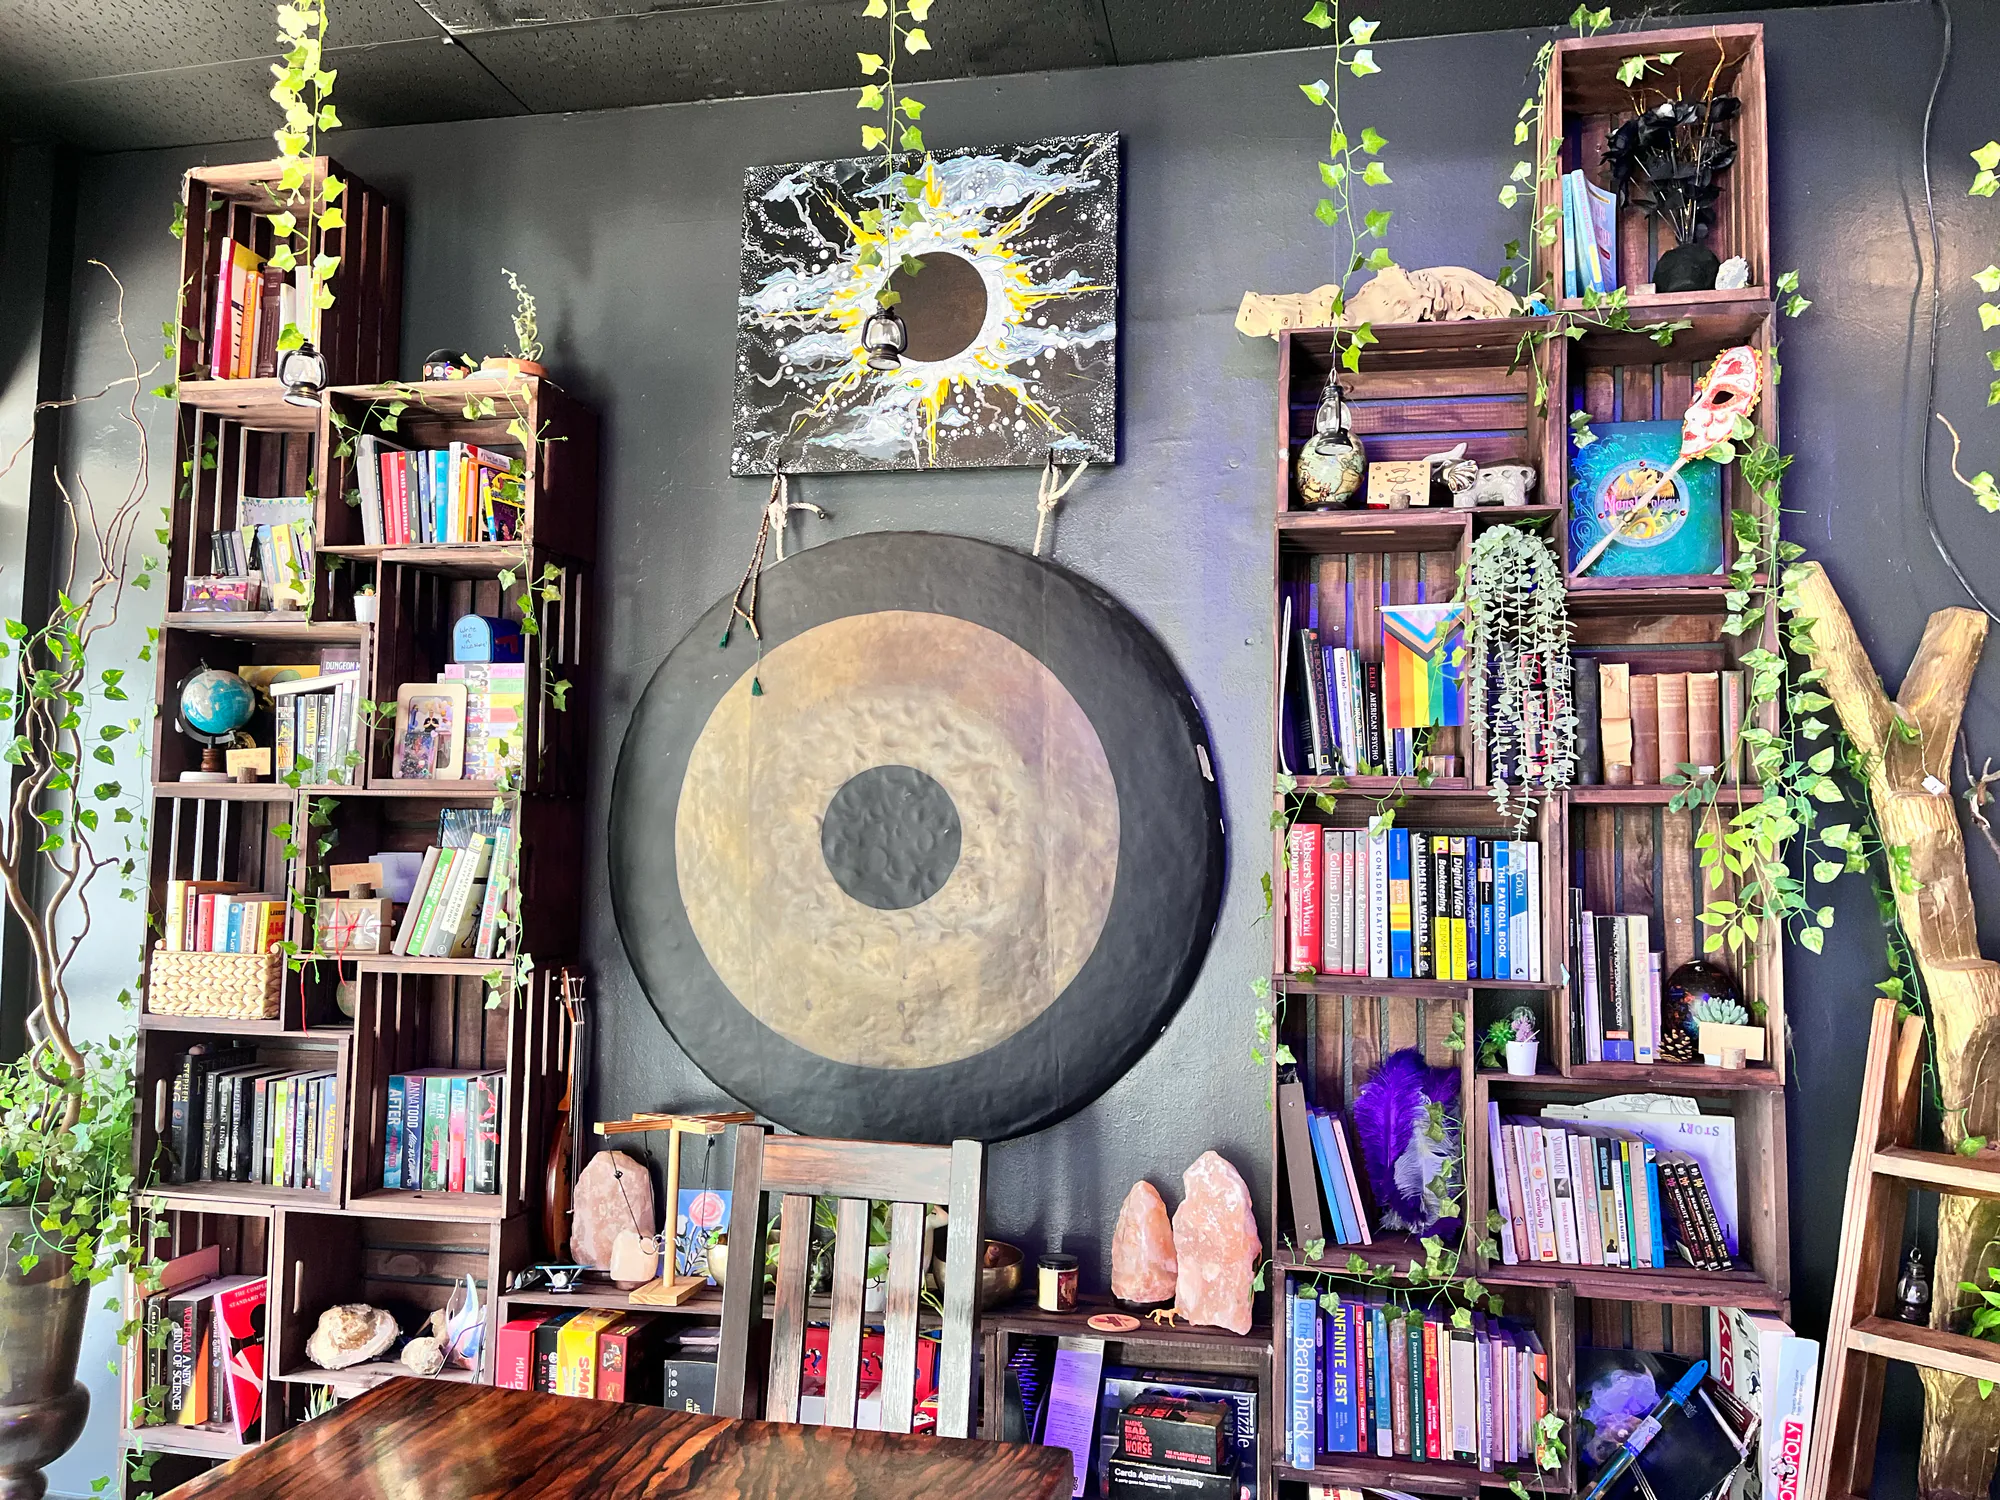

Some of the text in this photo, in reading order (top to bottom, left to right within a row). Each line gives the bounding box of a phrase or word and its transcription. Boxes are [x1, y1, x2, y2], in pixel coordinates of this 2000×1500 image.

[1604, 495, 1678, 515] Monstology
[325, 660, 352, 671] DUNGEON
[1317, 682, 1323, 692] OF
[1318, 694, 1328, 749] PHOTOGRAPHY
[1369, 692, 1377, 730] AMERICAN
[1291, 830, 1302, 886] Dictionary
[1418, 838, 1426, 852] AN
[449, 856, 476, 928] AUTOMATE THE BORING
[1302, 830, 1315, 937] Webster's New World
[1419, 855, 1427, 901] IMMENSE
[1438, 859, 1447, 911] Bookkeeping
[1498, 866, 1506, 884] THE
[1515, 872, 1524, 899] GOAL
[446, 896, 459, 922] PYTHON
[1327, 853, 1339, 949] Collins Dictionary
[1343, 853, 1352, 938] Collins Thesaurus
[1452, 857, 1464, 967] Digital Video DUMMIES
[1498, 887, 1506, 929] PAYROLL
[1467, 905, 1475, 929] GAMES
[1612, 923, 1620, 952] PRACTICAL
[1636, 942, 1648, 975] ETHICS
[388, 1089, 402, 1125] AFTER
[436, 1093, 446, 1119] AFTER
[456, 1090, 464, 1112] AFTER
[256, 1102, 264, 1138] EXORCIST
[326, 1104, 336, 1172] DIVERGENT
[1679, 1122, 1719, 1136] STORY
[1535, 1189, 1544, 1228] Growing Up
[1641, 1206, 1650, 1236] JOYCE
[1675, 1189, 1696, 1241] MIDNIGHT ALLEY
[1700, 1189, 1722, 1241] CARPE CORPUS
[229, 1295, 259, 1308] STANDARD
[182, 1306, 192, 1386] WOLFRAM A NEW
[1334, 1308, 1347, 1405] INFINITE JEST
[172, 1328, 182, 1410] KIND OF SCIENCE
[1295, 1302, 1313, 1439] Off the Beaten Track
[1125, 1426, 1146, 1435] BAD
[1233, 1396, 1250, 1448] puzzle
[1125, 1440, 1152, 1456] WORSE
[1115, 1468, 1204, 1489] Cards Against Humanity
